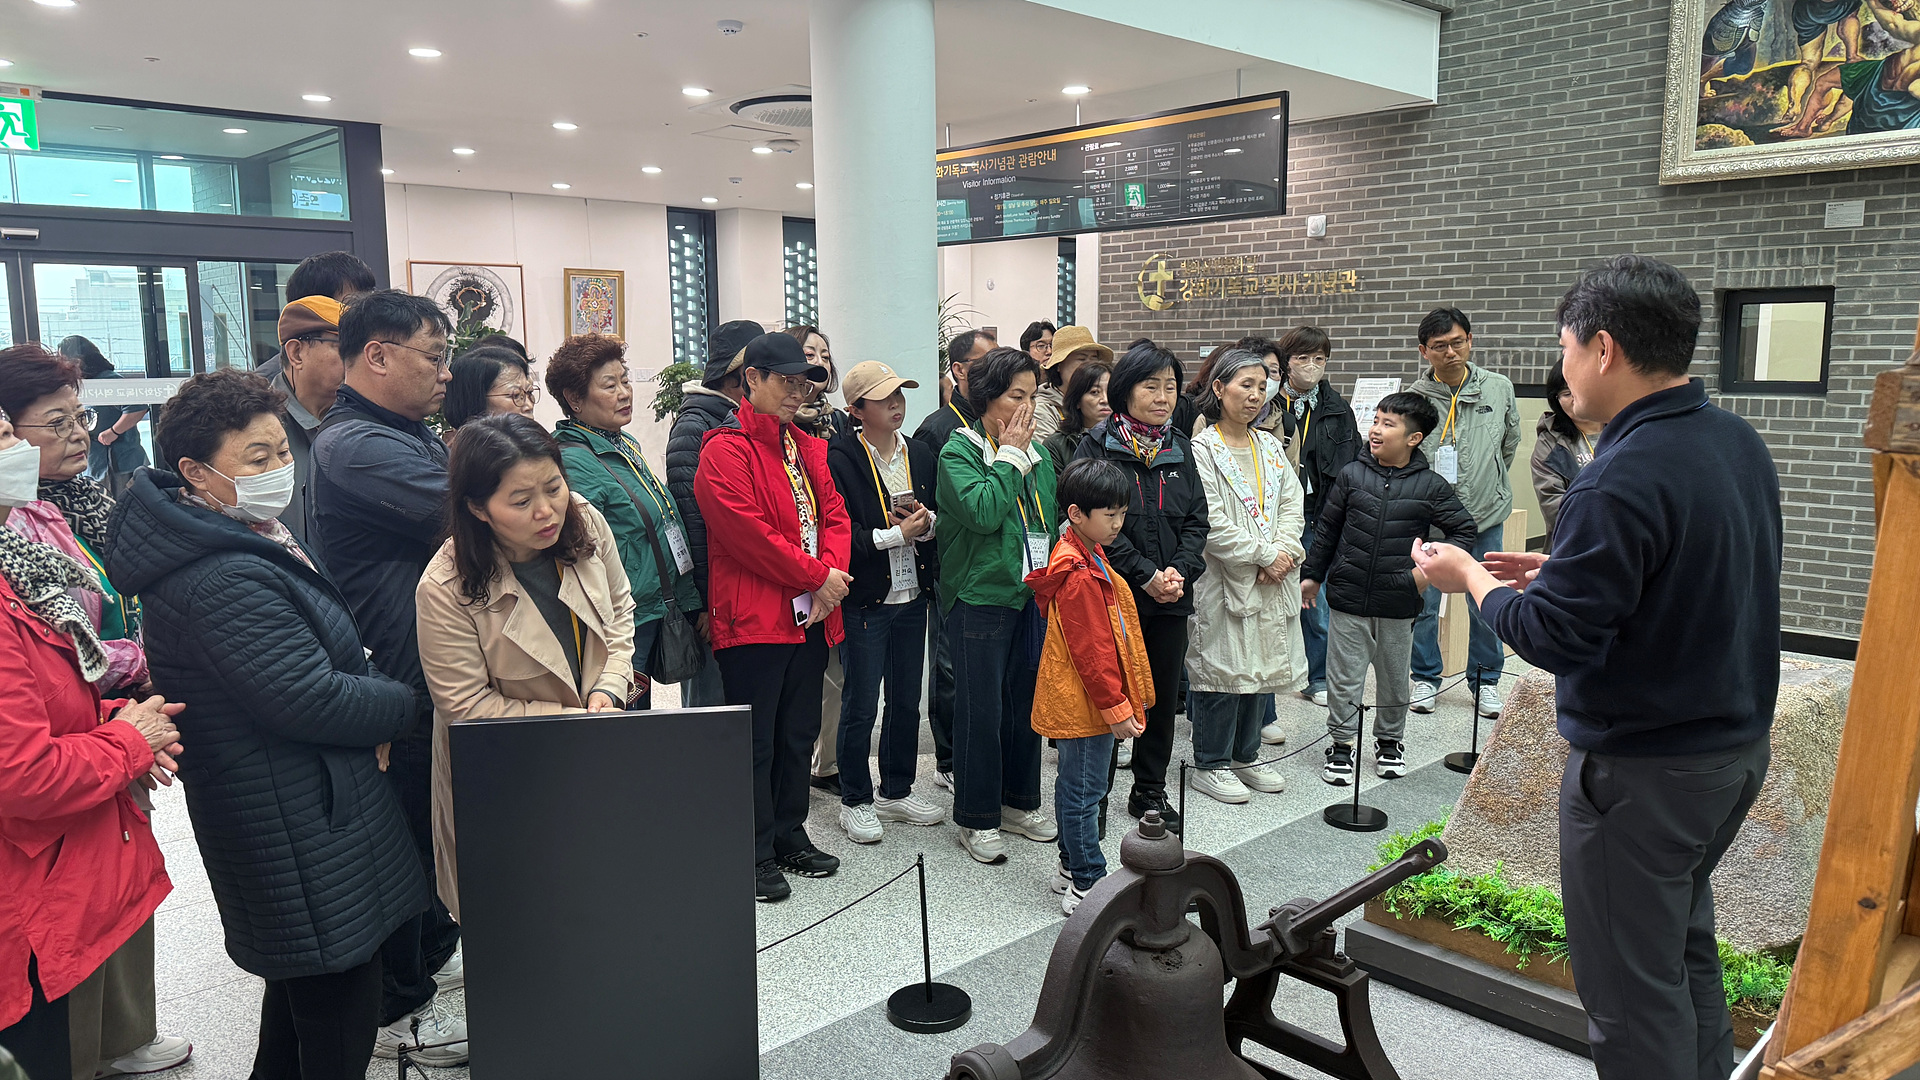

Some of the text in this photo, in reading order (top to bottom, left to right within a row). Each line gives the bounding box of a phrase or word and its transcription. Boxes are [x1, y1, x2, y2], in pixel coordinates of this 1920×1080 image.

[1018, 149, 1057, 168] 관람안내
[962, 174, 1016, 188] Visitor Information
[1179, 269, 1358, 301] 강화기독교 역사기념관
